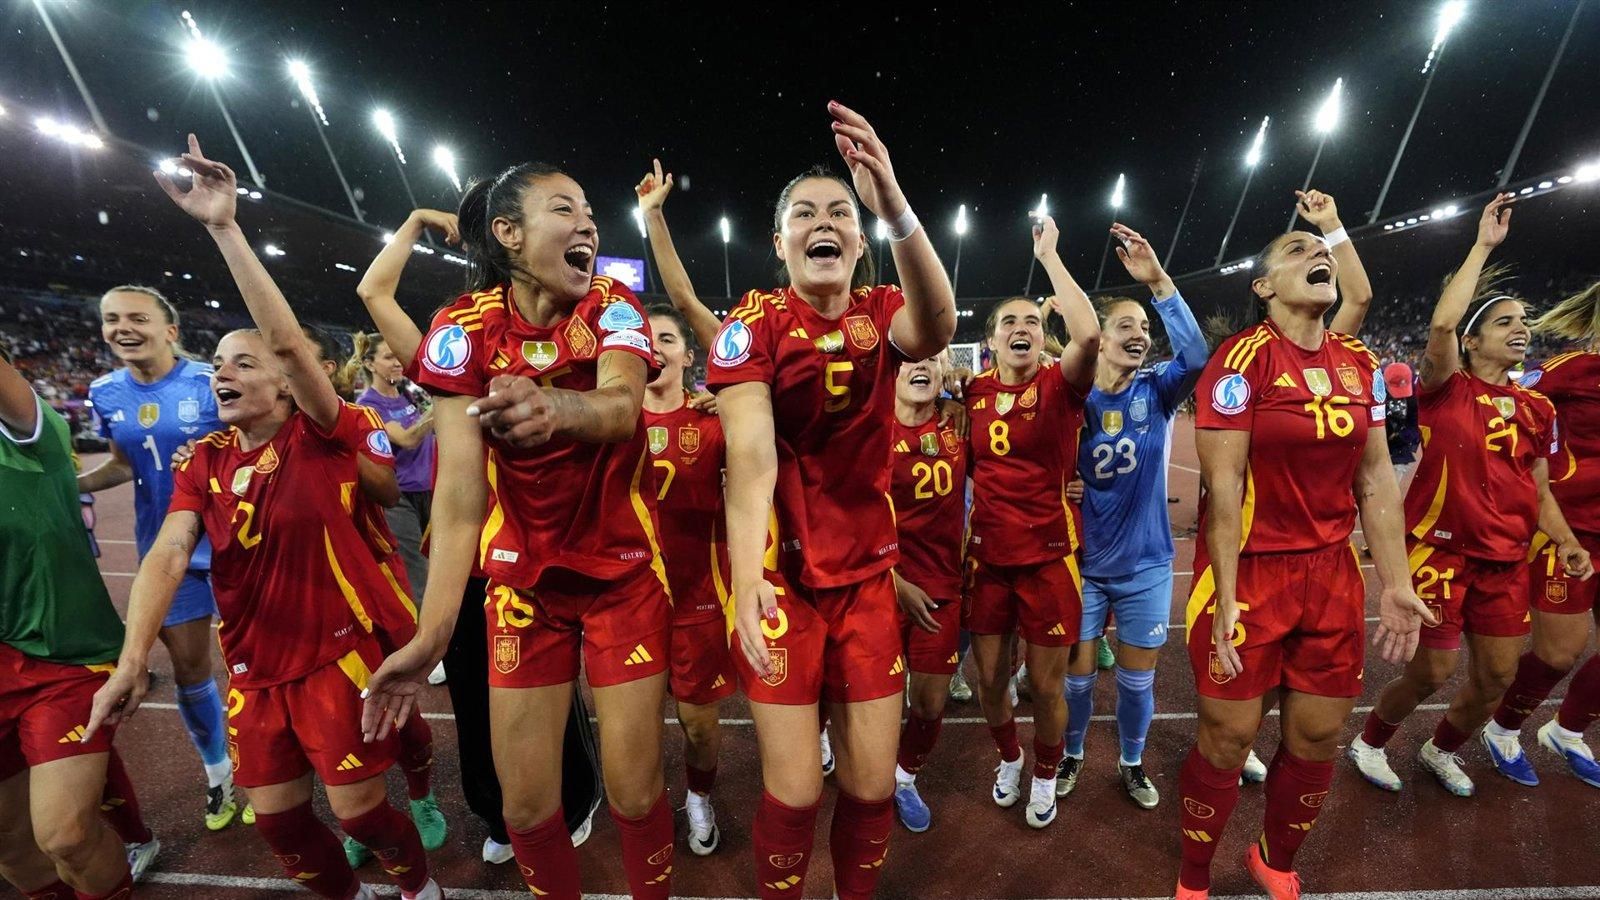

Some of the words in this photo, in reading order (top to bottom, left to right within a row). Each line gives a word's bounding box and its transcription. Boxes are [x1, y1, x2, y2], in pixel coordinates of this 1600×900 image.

[824, 361, 854, 413] 5
[988, 419, 1011, 456] 8
[1304, 395, 1355, 439] 16
[1485, 416, 1518, 458] 21
[142, 434, 163, 471] 1
[1092, 437, 1138, 480] 23
[653, 460, 676, 501] 7
[911, 460, 953, 500] 20
[231, 501, 263, 550] 2
[1416, 566, 1454, 600] 21
[493, 585, 534, 628] 15
